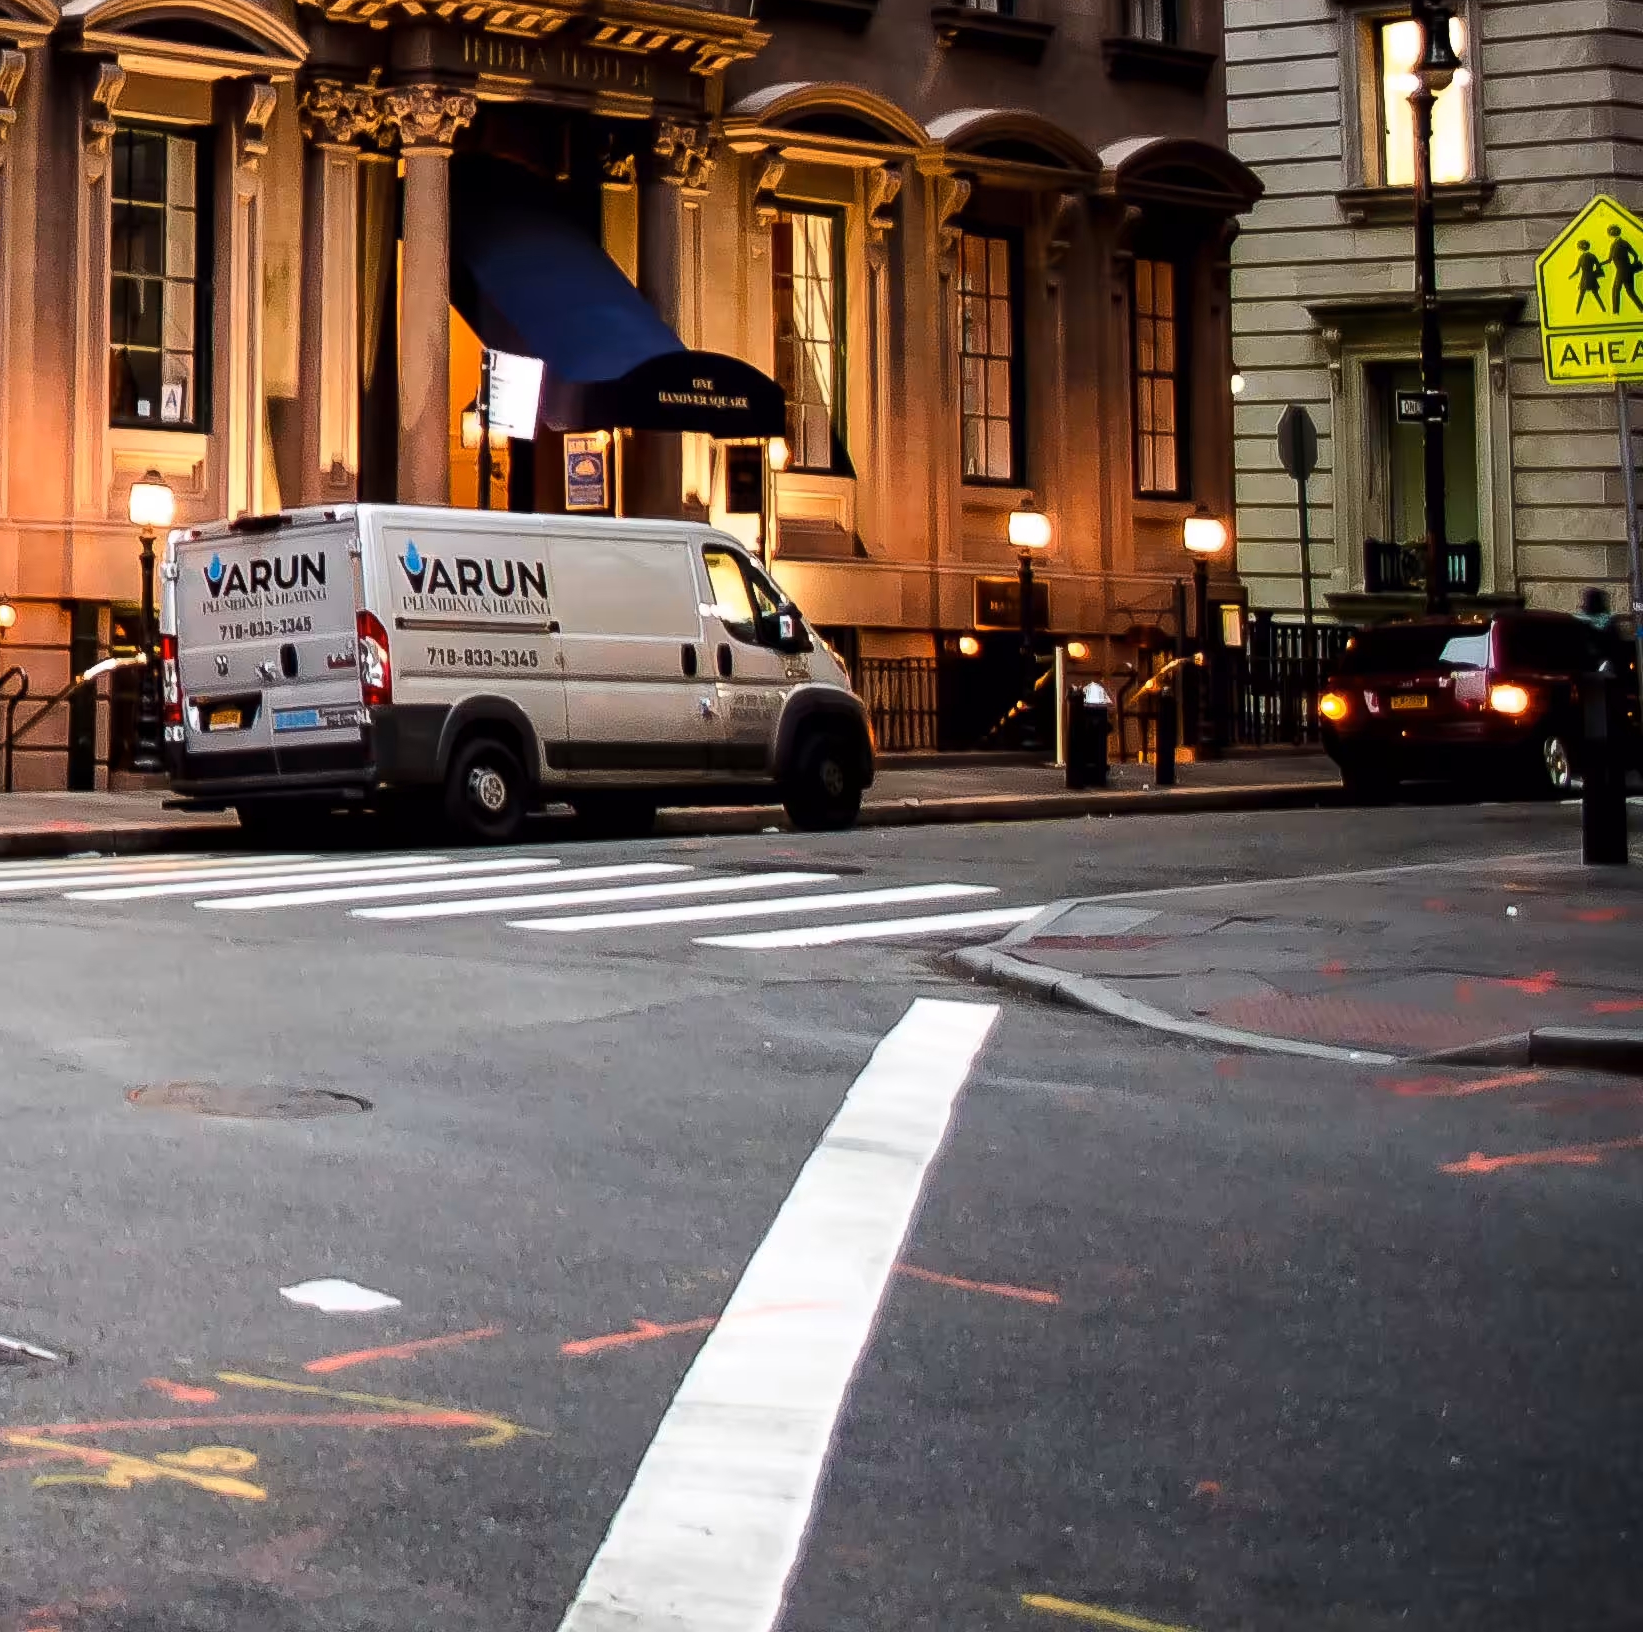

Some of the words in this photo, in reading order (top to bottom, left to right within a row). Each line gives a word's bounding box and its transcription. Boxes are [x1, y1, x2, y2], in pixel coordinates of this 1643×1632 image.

[658, 391, 707, 405] HANOVER
[203, 552, 327, 598] VARUN
[398, 556, 548, 599] VARUN
[403, 595, 479, 612] PLUMBING
[493, 599, 552, 615] HEATING
